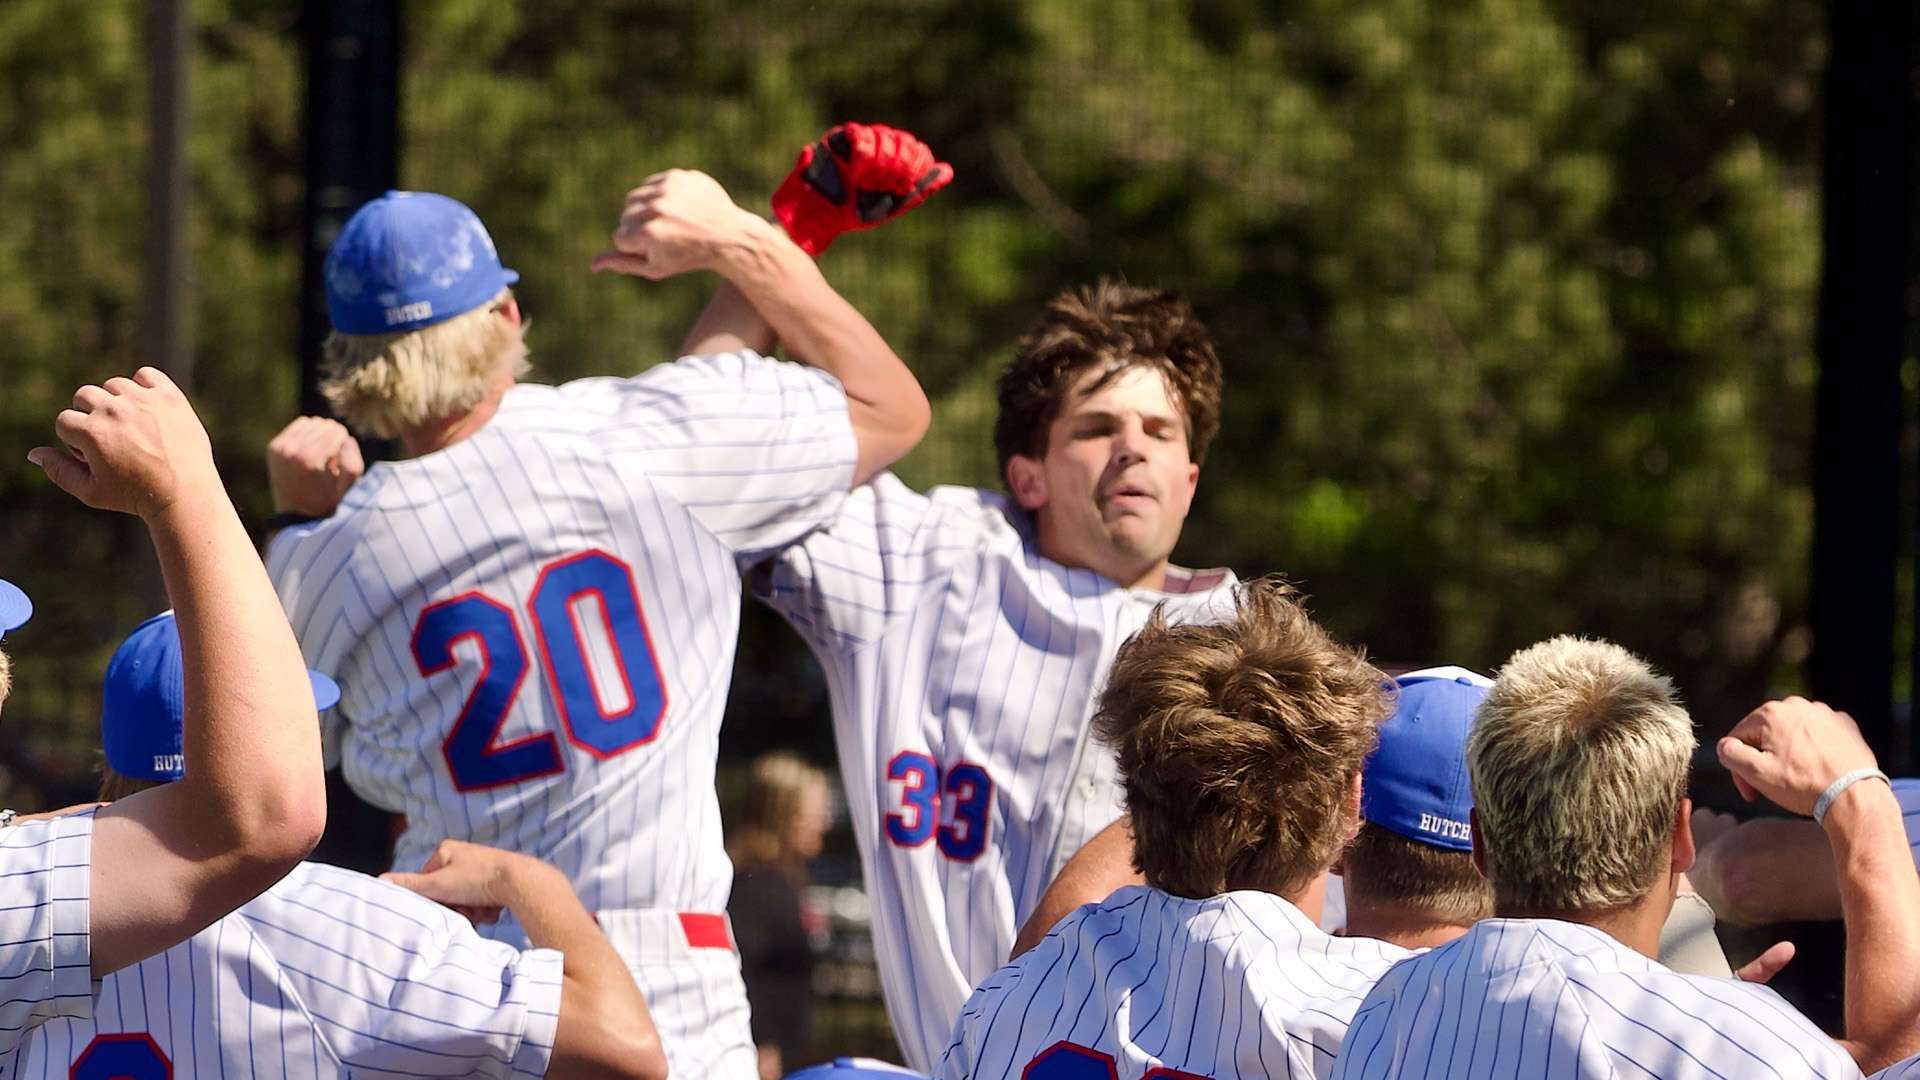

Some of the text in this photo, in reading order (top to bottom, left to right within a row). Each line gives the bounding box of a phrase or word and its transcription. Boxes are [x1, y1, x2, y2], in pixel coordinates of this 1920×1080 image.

[409, 547, 669, 794] 20
[884, 749, 993, 864] 33
[1418, 812, 1472, 841] HUTCH
